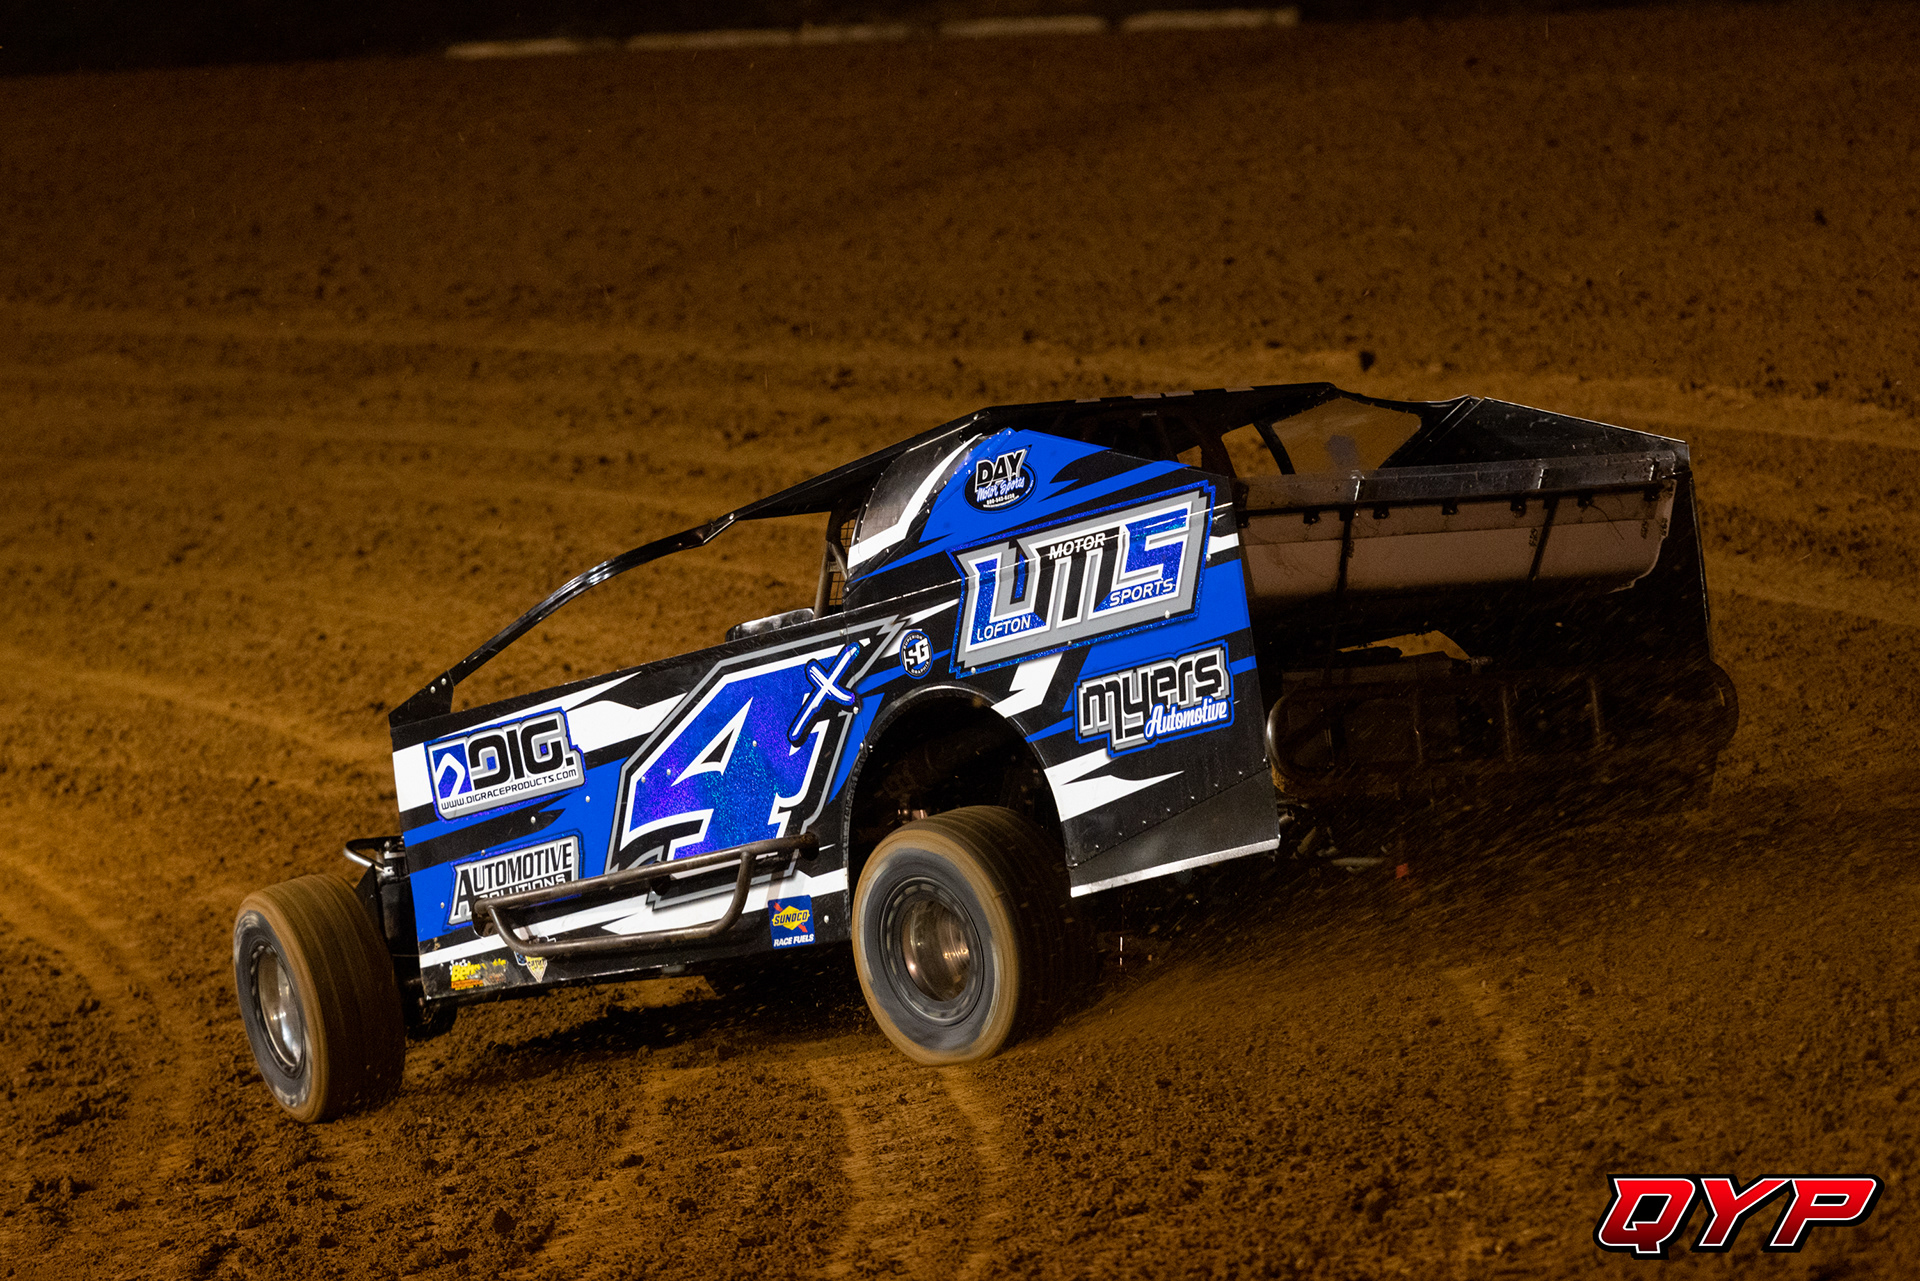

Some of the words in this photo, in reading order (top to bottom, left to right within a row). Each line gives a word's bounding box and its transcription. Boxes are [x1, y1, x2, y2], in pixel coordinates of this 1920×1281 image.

[975, 449, 1027, 493] DAY
[977, 484, 999, 502] Motor
[1000, 477, 1025, 495] Sports
[1049, 532, 1106, 560] MOTOR
[1109, 578, 1176, 607] SPORTS
[977, 614, 1031, 642] LOFTON
[1145, 697, 1228, 738] Automotive
[454, 842, 572, 917] AUTOMOTIVE
[479, 873, 566, 898] UTIONS
[774, 911, 808, 925] SUNOCO
[773, 936, 793, 947] RACE
[793, 934, 814, 944] FUELS
